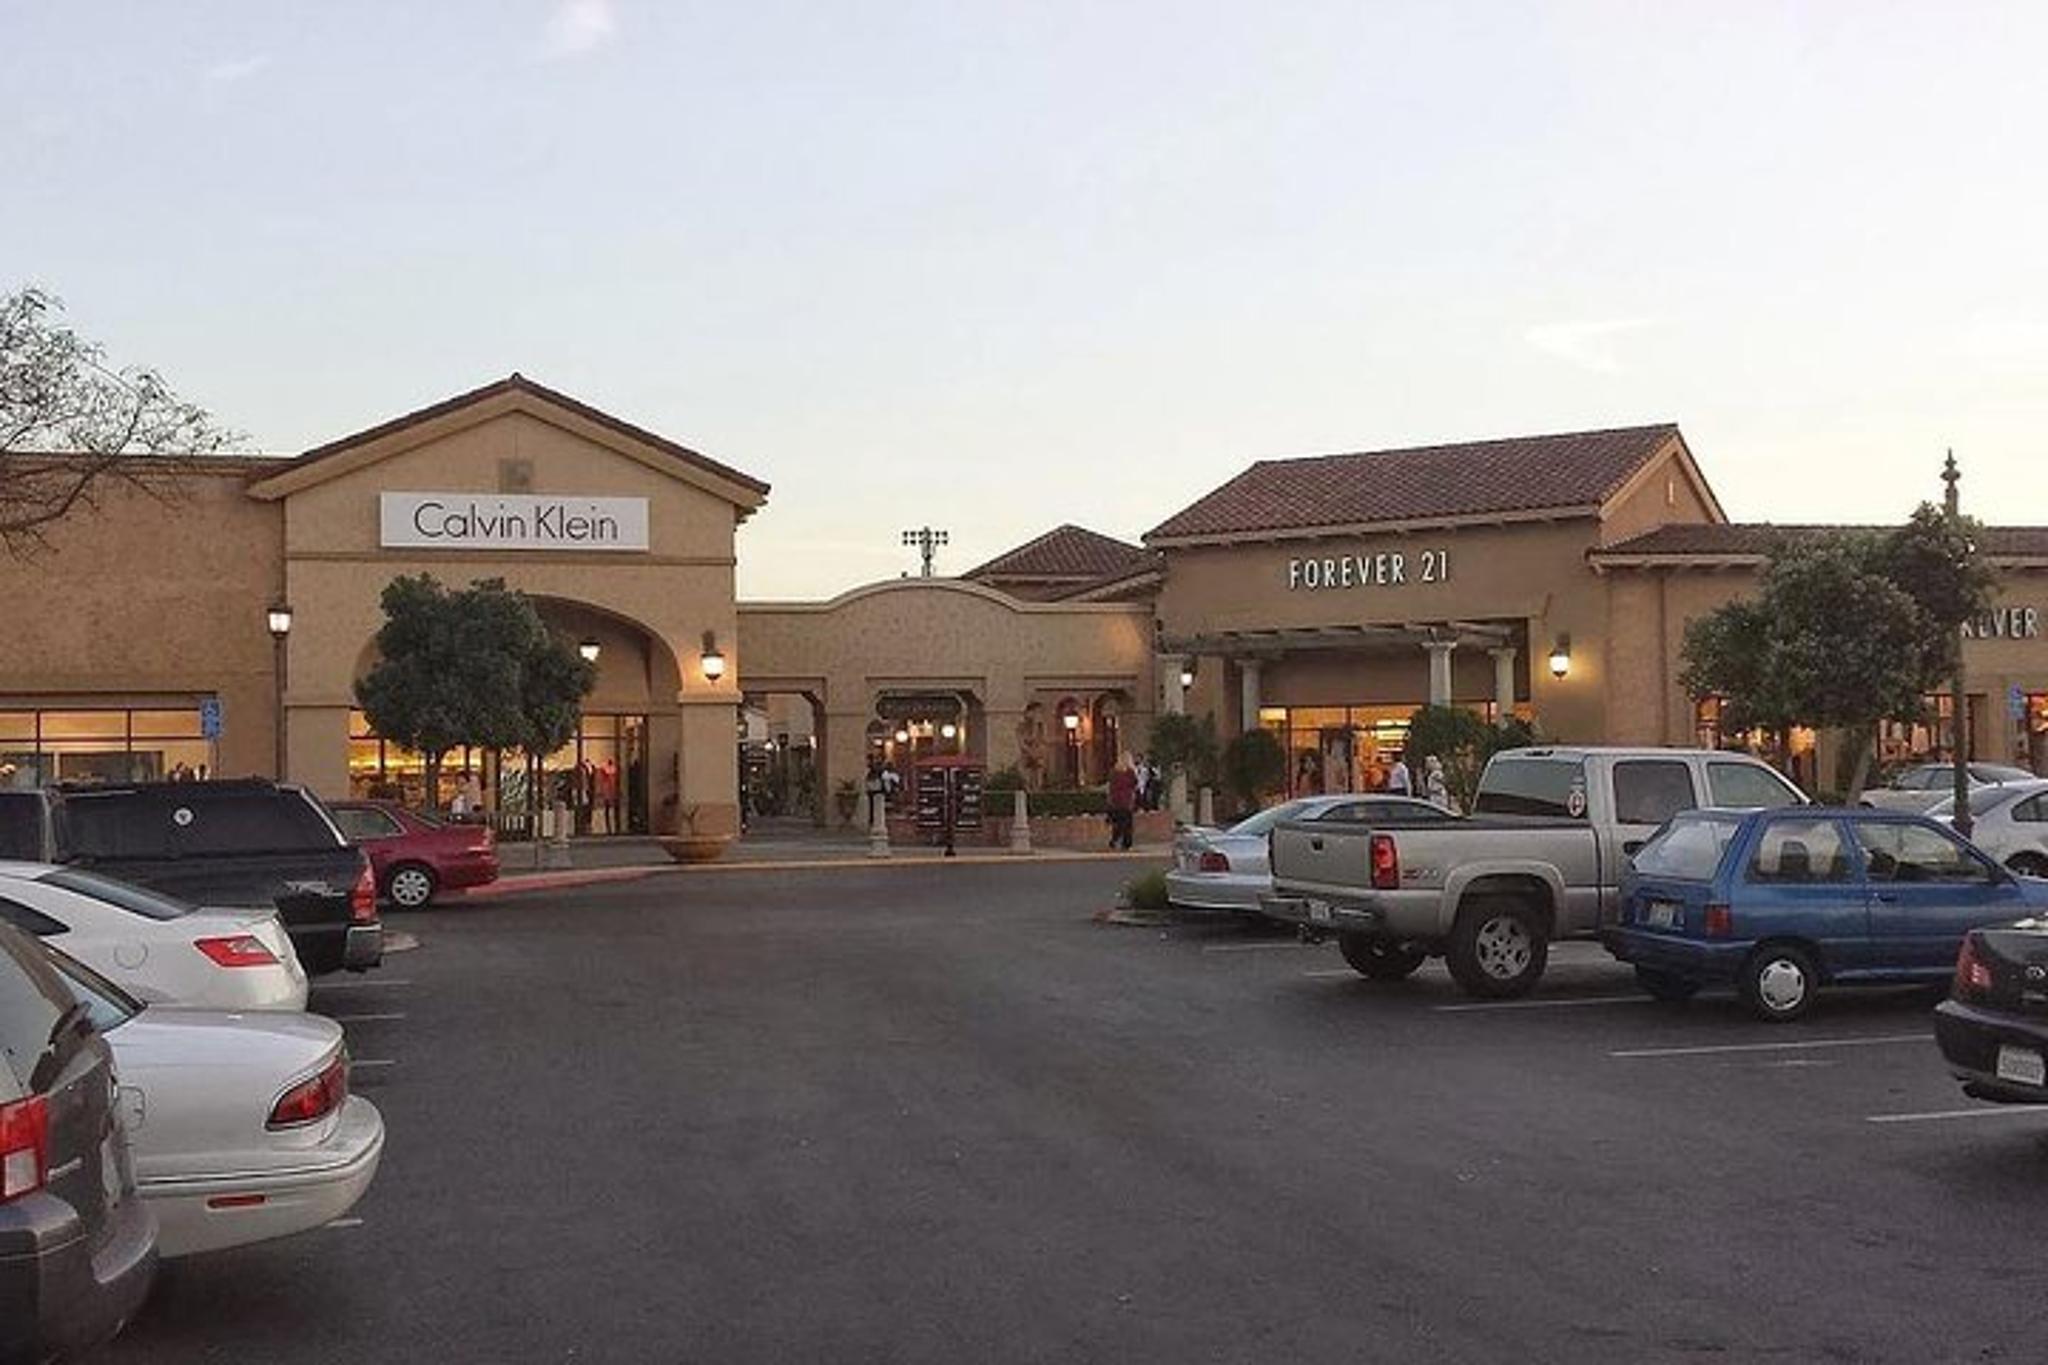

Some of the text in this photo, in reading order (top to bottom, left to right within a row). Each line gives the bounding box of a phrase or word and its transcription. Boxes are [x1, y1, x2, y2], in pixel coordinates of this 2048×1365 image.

[413, 502, 619, 541] Calvin Klein
[1289, 550, 1447, 589] FOREVER 21
